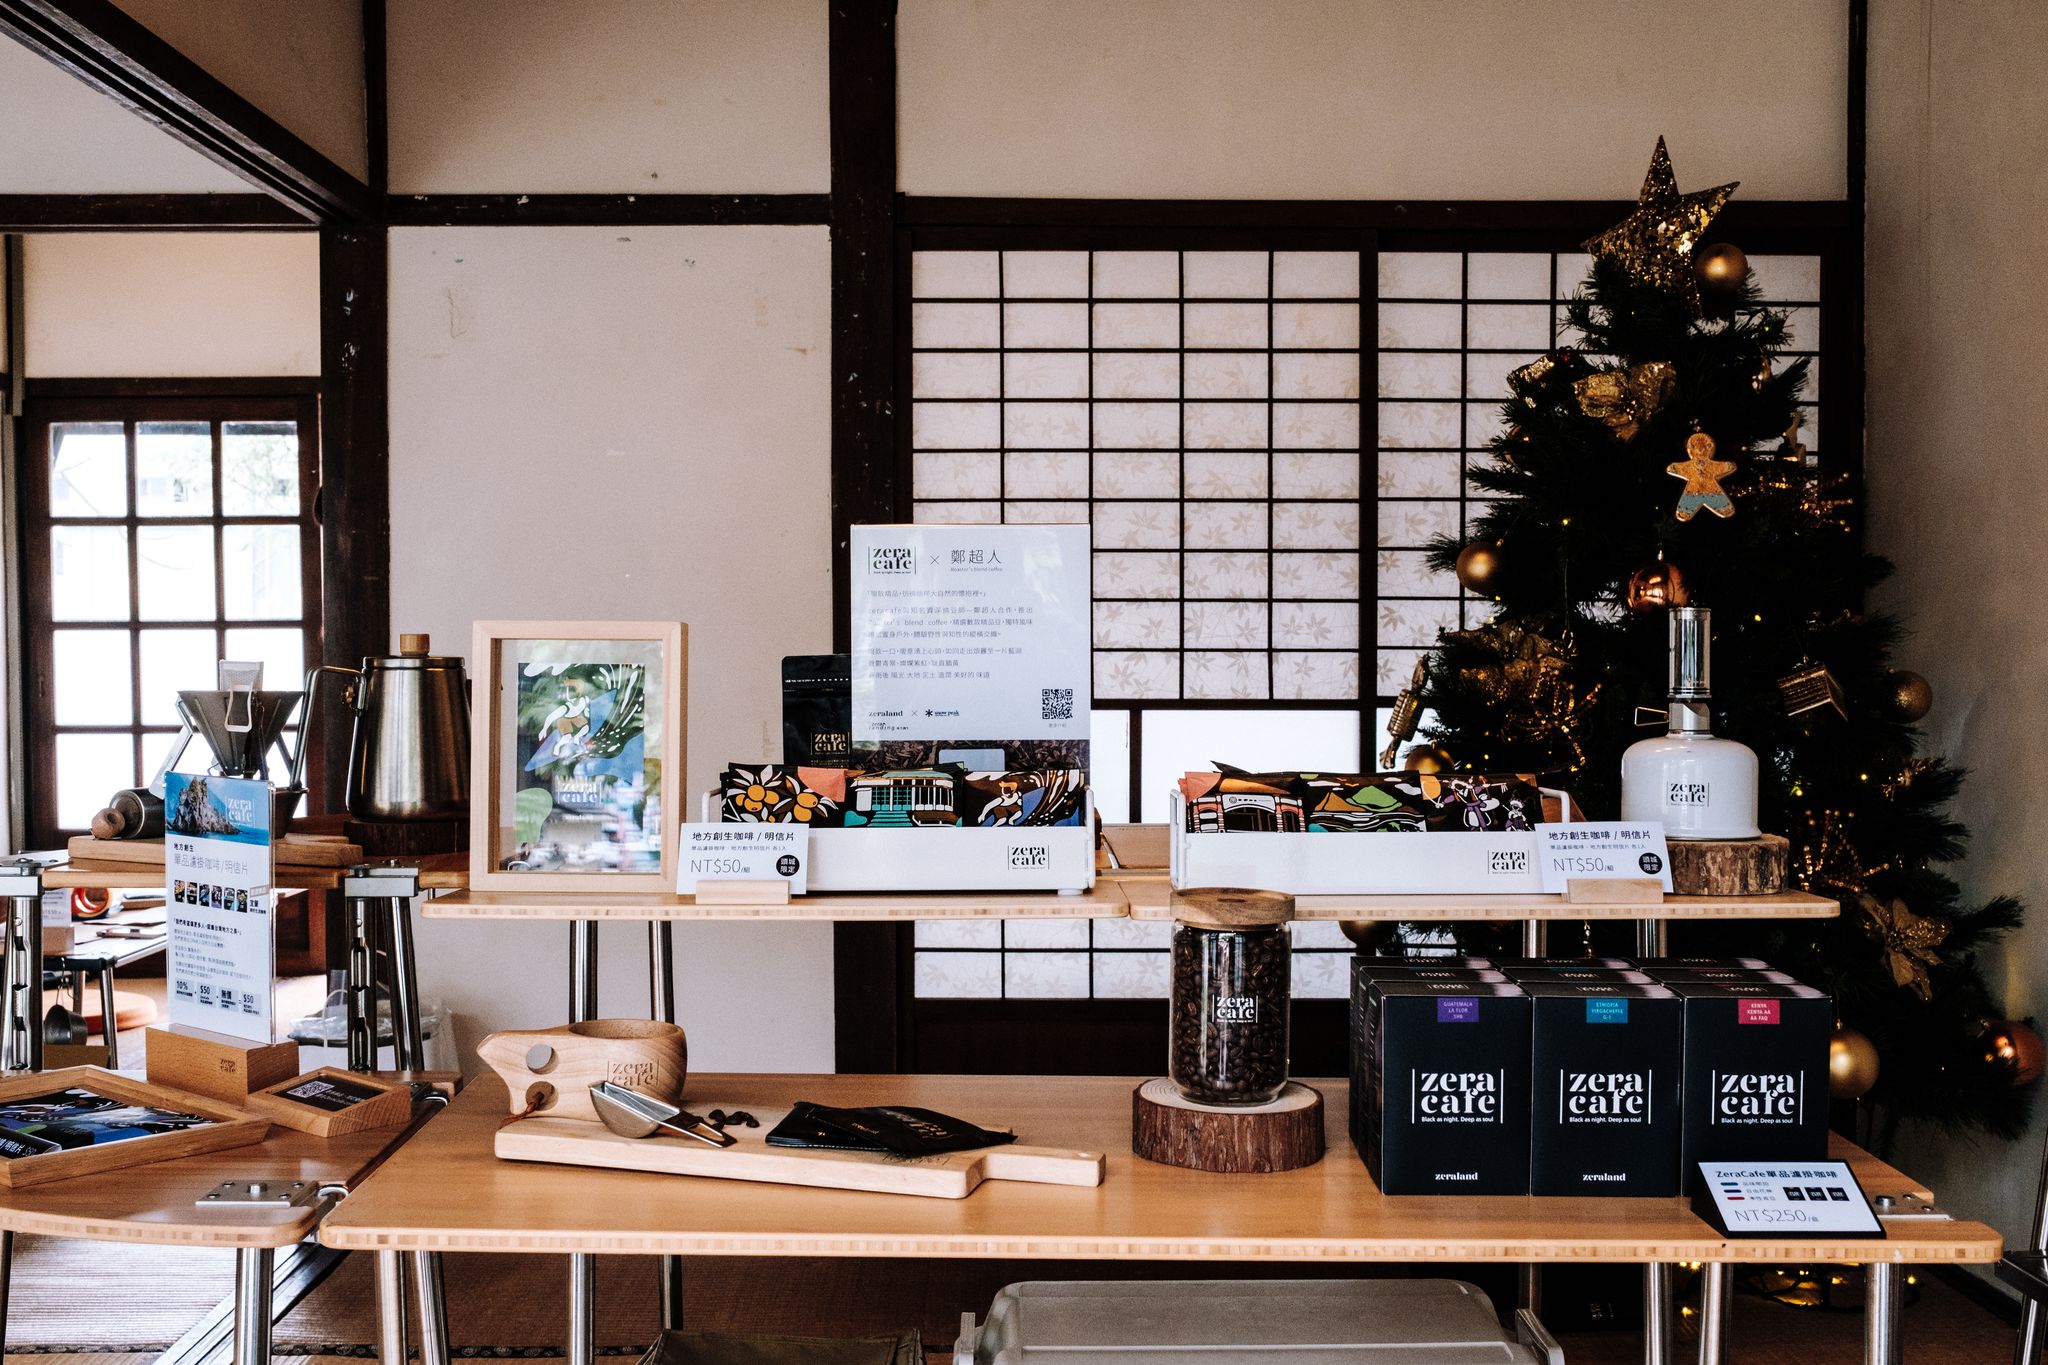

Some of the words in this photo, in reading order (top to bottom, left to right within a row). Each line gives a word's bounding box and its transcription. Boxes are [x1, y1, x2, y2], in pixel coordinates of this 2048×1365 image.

[873, 548, 911, 558] zera
[951, 549, 1002, 564] 鄭超人
[873, 555, 912, 569] cafe
[814, 733, 846, 743] zera
[814, 740, 846, 751] cafe
[1670, 783, 1705, 793] zera
[562, 791, 598, 803] cafe
[1670, 791, 1706, 803] cafe
[228, 798, 252, 810] zera
[228, 808, 253, 823] cafe
[692, 832, 754, 841] 地方創生咖啡
[764, 832, 794, 841] 明信片
[1548, 831, 1611, 840] 地方創生咖啡
[1620, 830, 1651, 840] 明信片
[1011, 847, 1045, 856] zera
[1491, 851, 1525, 861] zera
[1011, 854, 1046, 866] cafe
[1491, 859, 1526, 871] cafe
[780, 866, 796, 874] 限定
[1643, 863, 1659, 871] 限定
[1216, 996, 1254, 1008] zera
[1216, 1005, 1255, 1019] cafe
[612, 1062, 653, 1074] zera
[612, 1073, 654, 1086] cafe
[1421, 1073, 1496, 1092] zera
[1569, 1073, 1644, 1093] zera
[1721, 1074, 1796, 1094] zera
[1420, 1087, 1496, 1114] cafe
[1569, 1088, 1643, 1114] cafe
[1720, 1089, 1795, 1115] cafe
[1569, 1116, 1584, 1124] Black
[1584, 1116, 1591, 1124] as
[1608, 1116, 1623, 1124] Deep
[1623, 1116, 1630, 1124] as
[1630, 1116, 1642, 1124] soul
[1721, 1117, 1736, 1125] Black
[1736, 1117, 1743, 1125] as
[1760, 1117, 1775, 1125] Deep
[1775, 1117, 1782, 1125] as
[1782, 1117, 1793, 1125] soul
[1434, 1172, 1479, 1181] zeraland
[1582, 1172, 1626, 1181] zeraland
